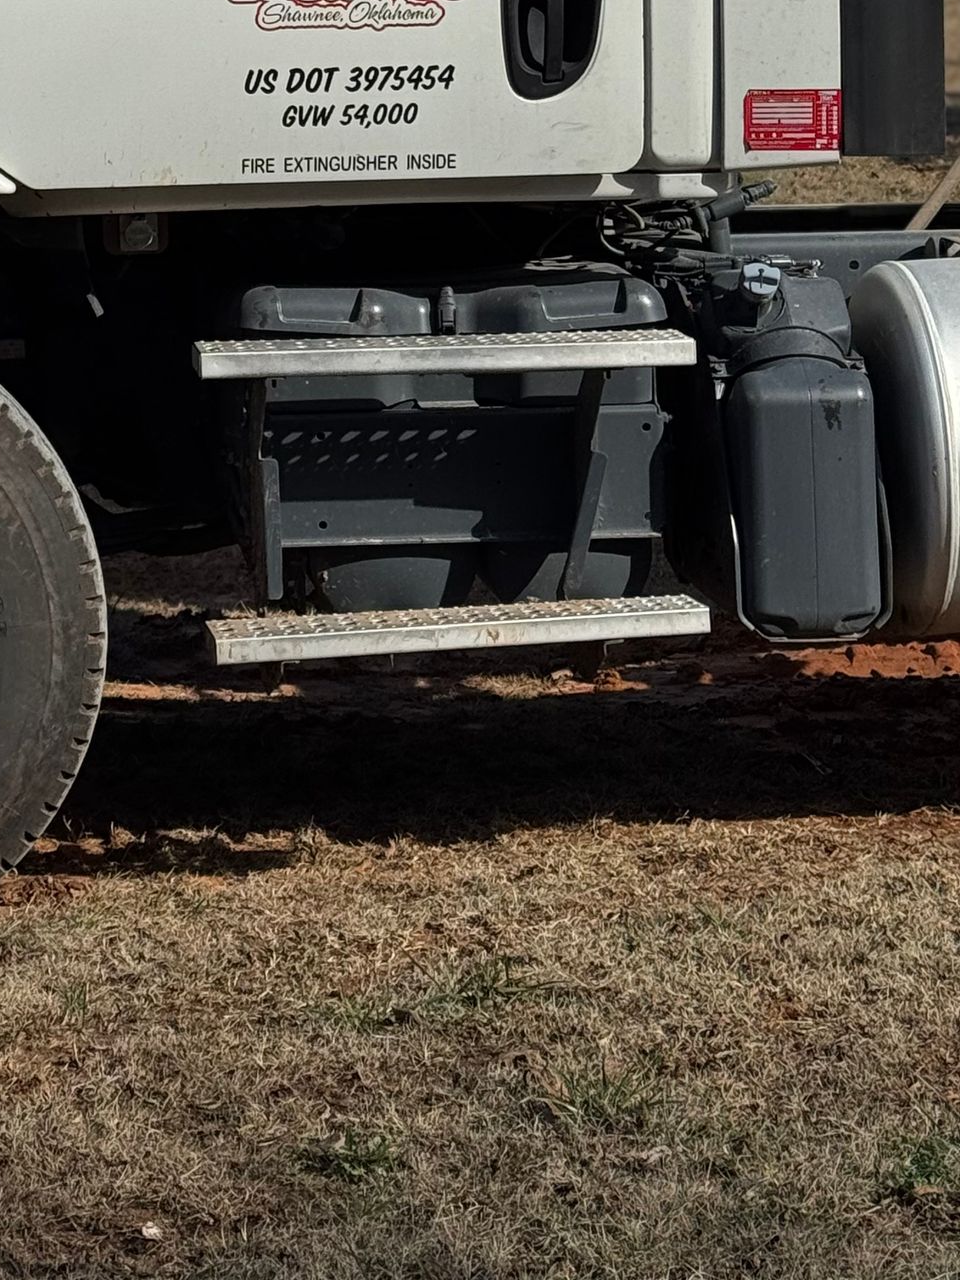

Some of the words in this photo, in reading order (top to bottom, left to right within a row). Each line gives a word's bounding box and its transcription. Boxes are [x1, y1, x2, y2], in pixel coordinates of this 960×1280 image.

[348, 1, 439, 25] Oklahoma
[244, 68, 279, 95] US
[285, 66, 340, 94] DOT
[344, 64, 455, 93] 3975454
[281, 104, 336, 128] GVW
[339, 102, 419, 129] 54,000
[241, 158, 276, 174] FIRE
[283, 154, 398, 173] EXTINGUISHER
[405, 153, 457, 170] INSIDE
